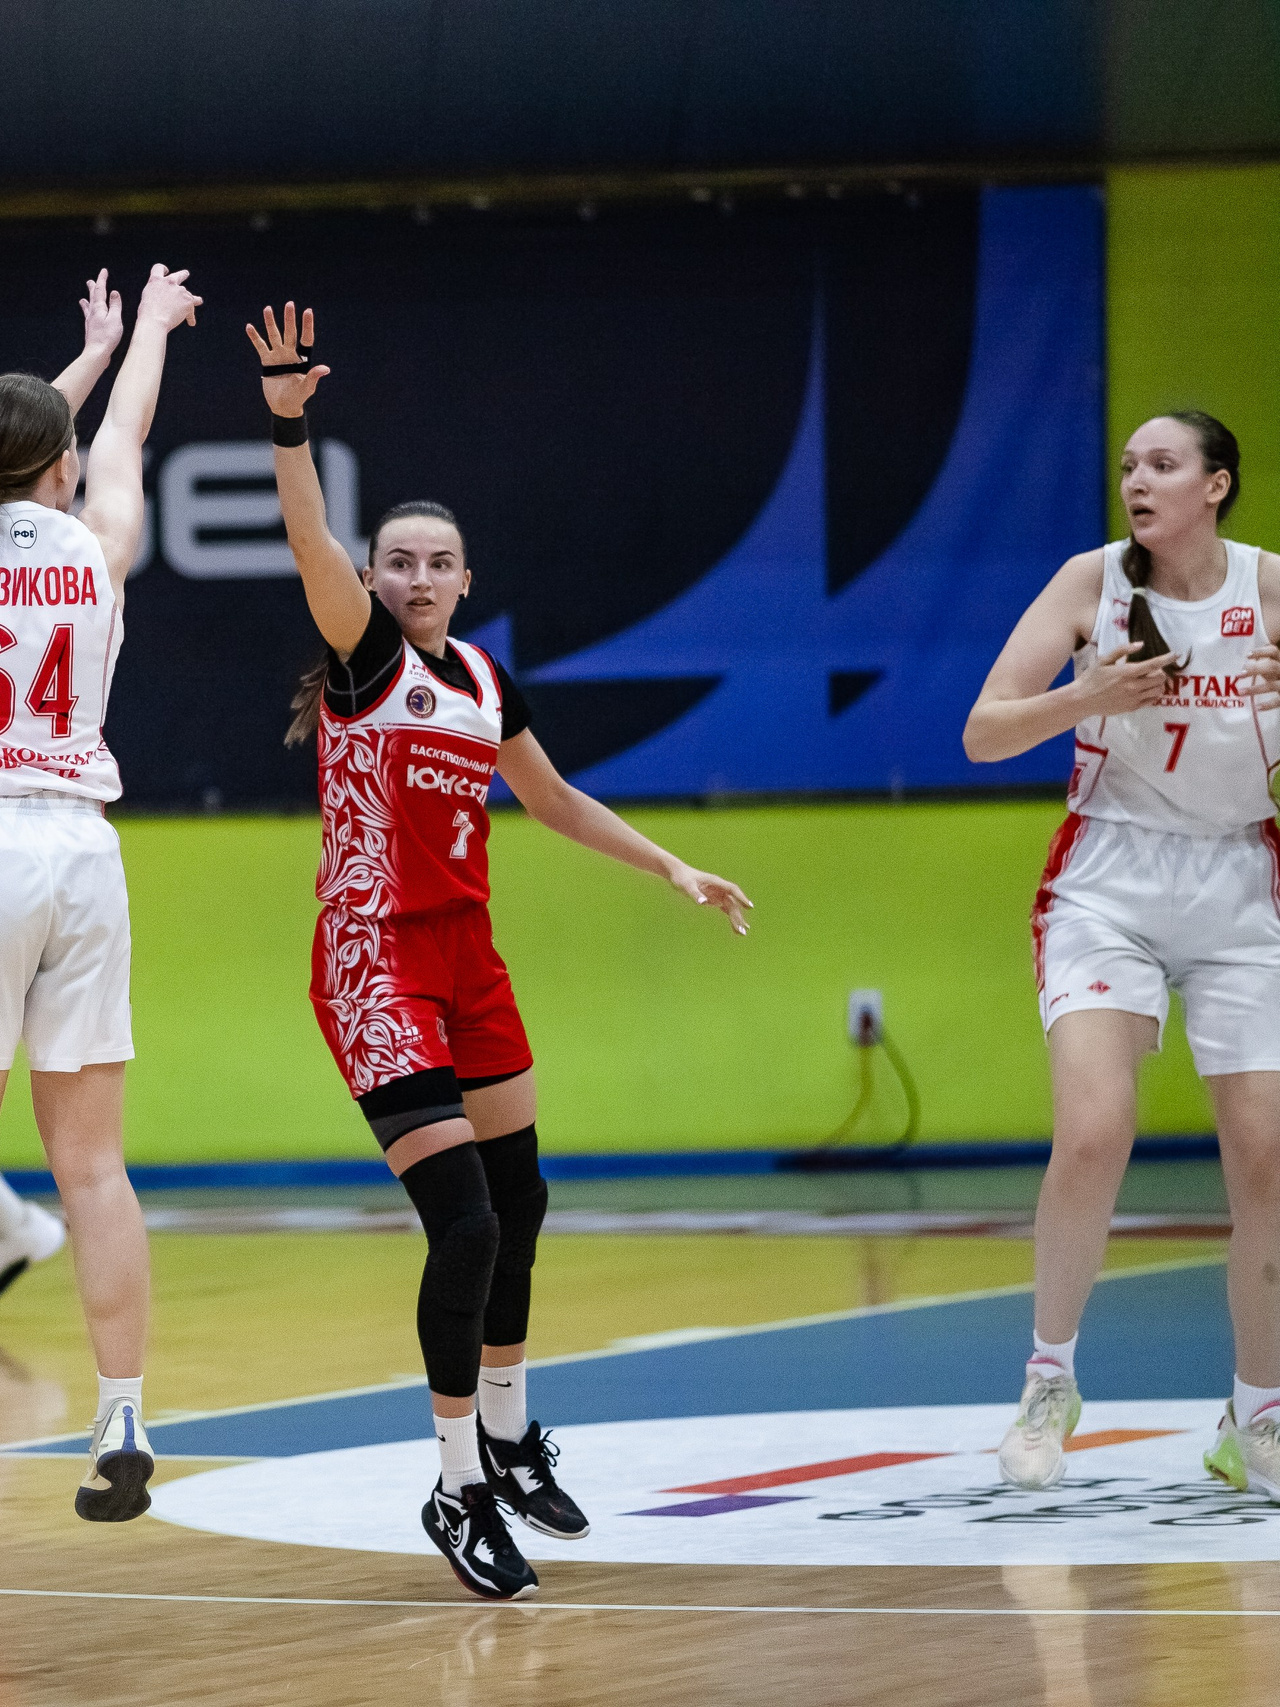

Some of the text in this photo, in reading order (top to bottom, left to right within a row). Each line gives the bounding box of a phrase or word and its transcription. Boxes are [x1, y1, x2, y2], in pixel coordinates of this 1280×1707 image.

[14, 530, 35, 538] РФБ
[410, 743, 489, 775] БАСКЕТБОЛЬНЫЙ
[1164, 722, 1189, 773] 7
[394, 1034, 423, 1048] SPORT
